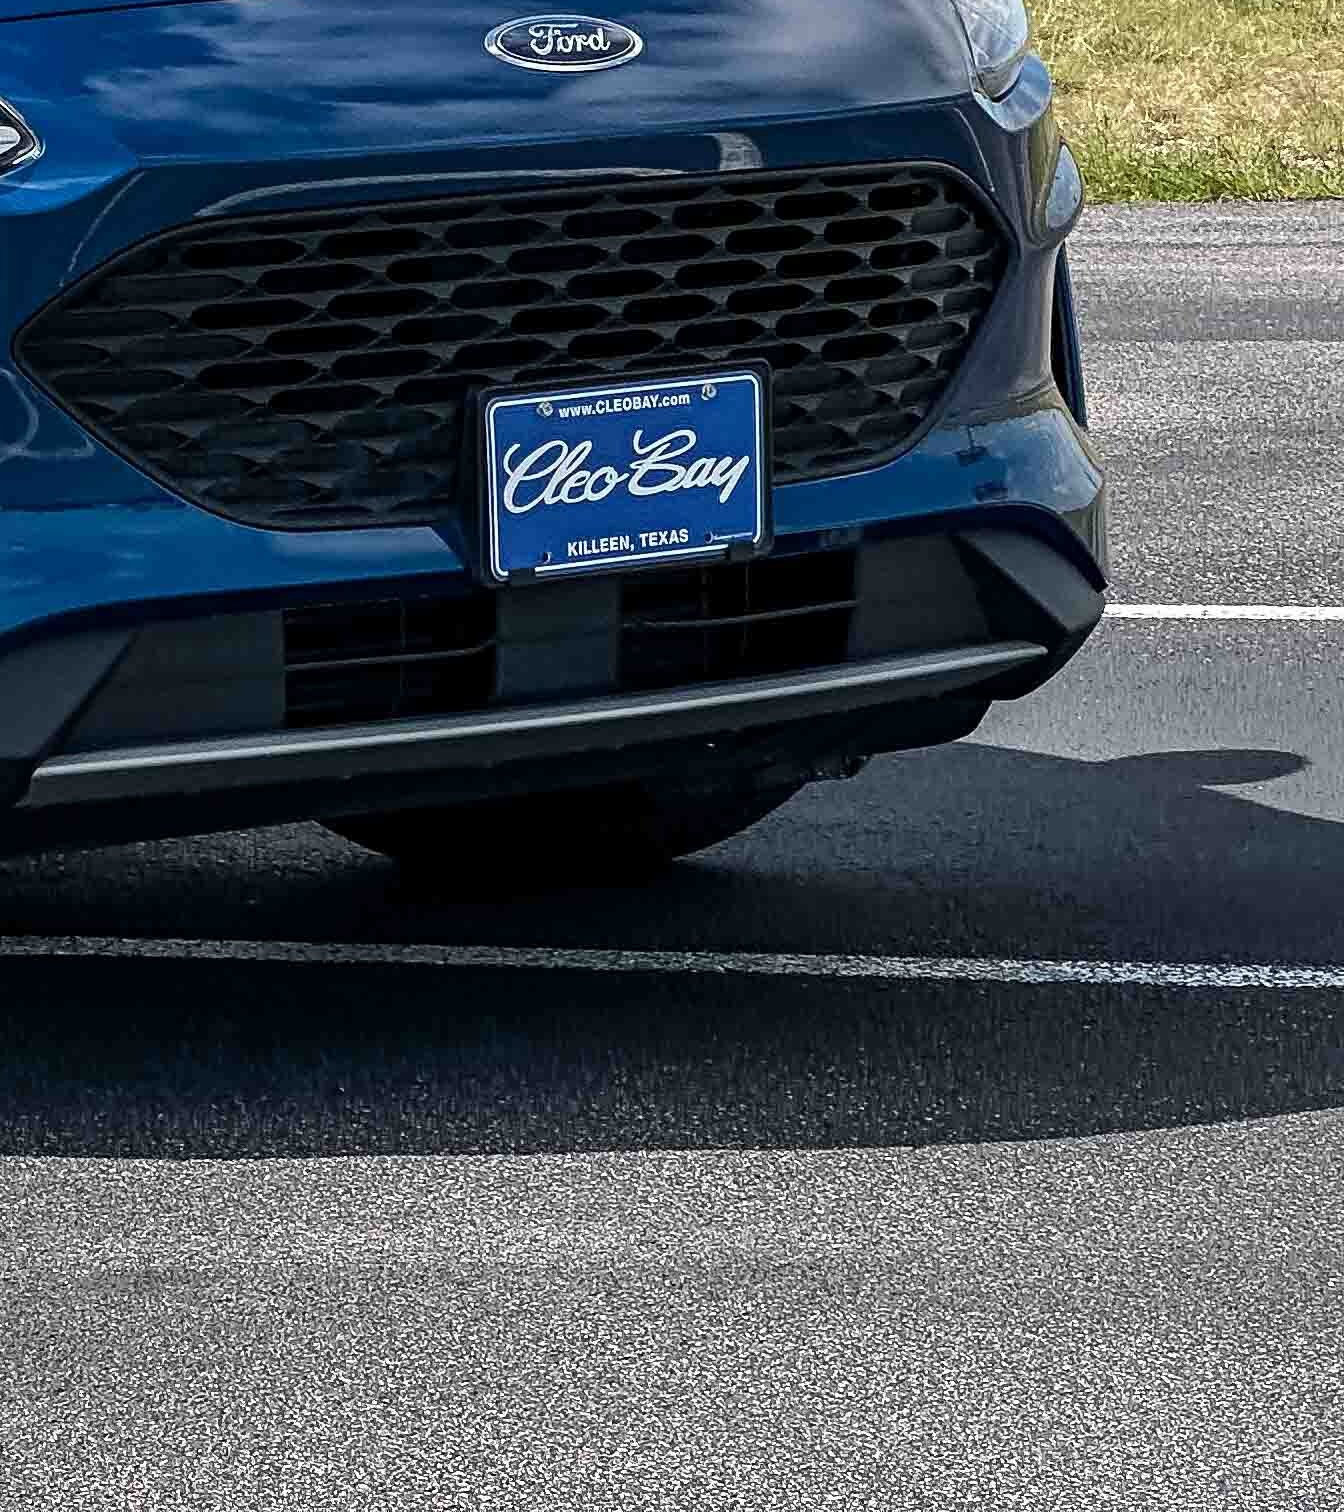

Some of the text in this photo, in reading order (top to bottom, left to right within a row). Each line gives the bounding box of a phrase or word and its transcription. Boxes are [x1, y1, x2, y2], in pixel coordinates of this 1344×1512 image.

[528, 23, 611, 56] Ford
[558, 393, 691, 419] www.CLEOBAY.com
[503, 429, 751, 515] Cleo Bay
[566, 527, 690, 557] KILLEEN, TEXAS
